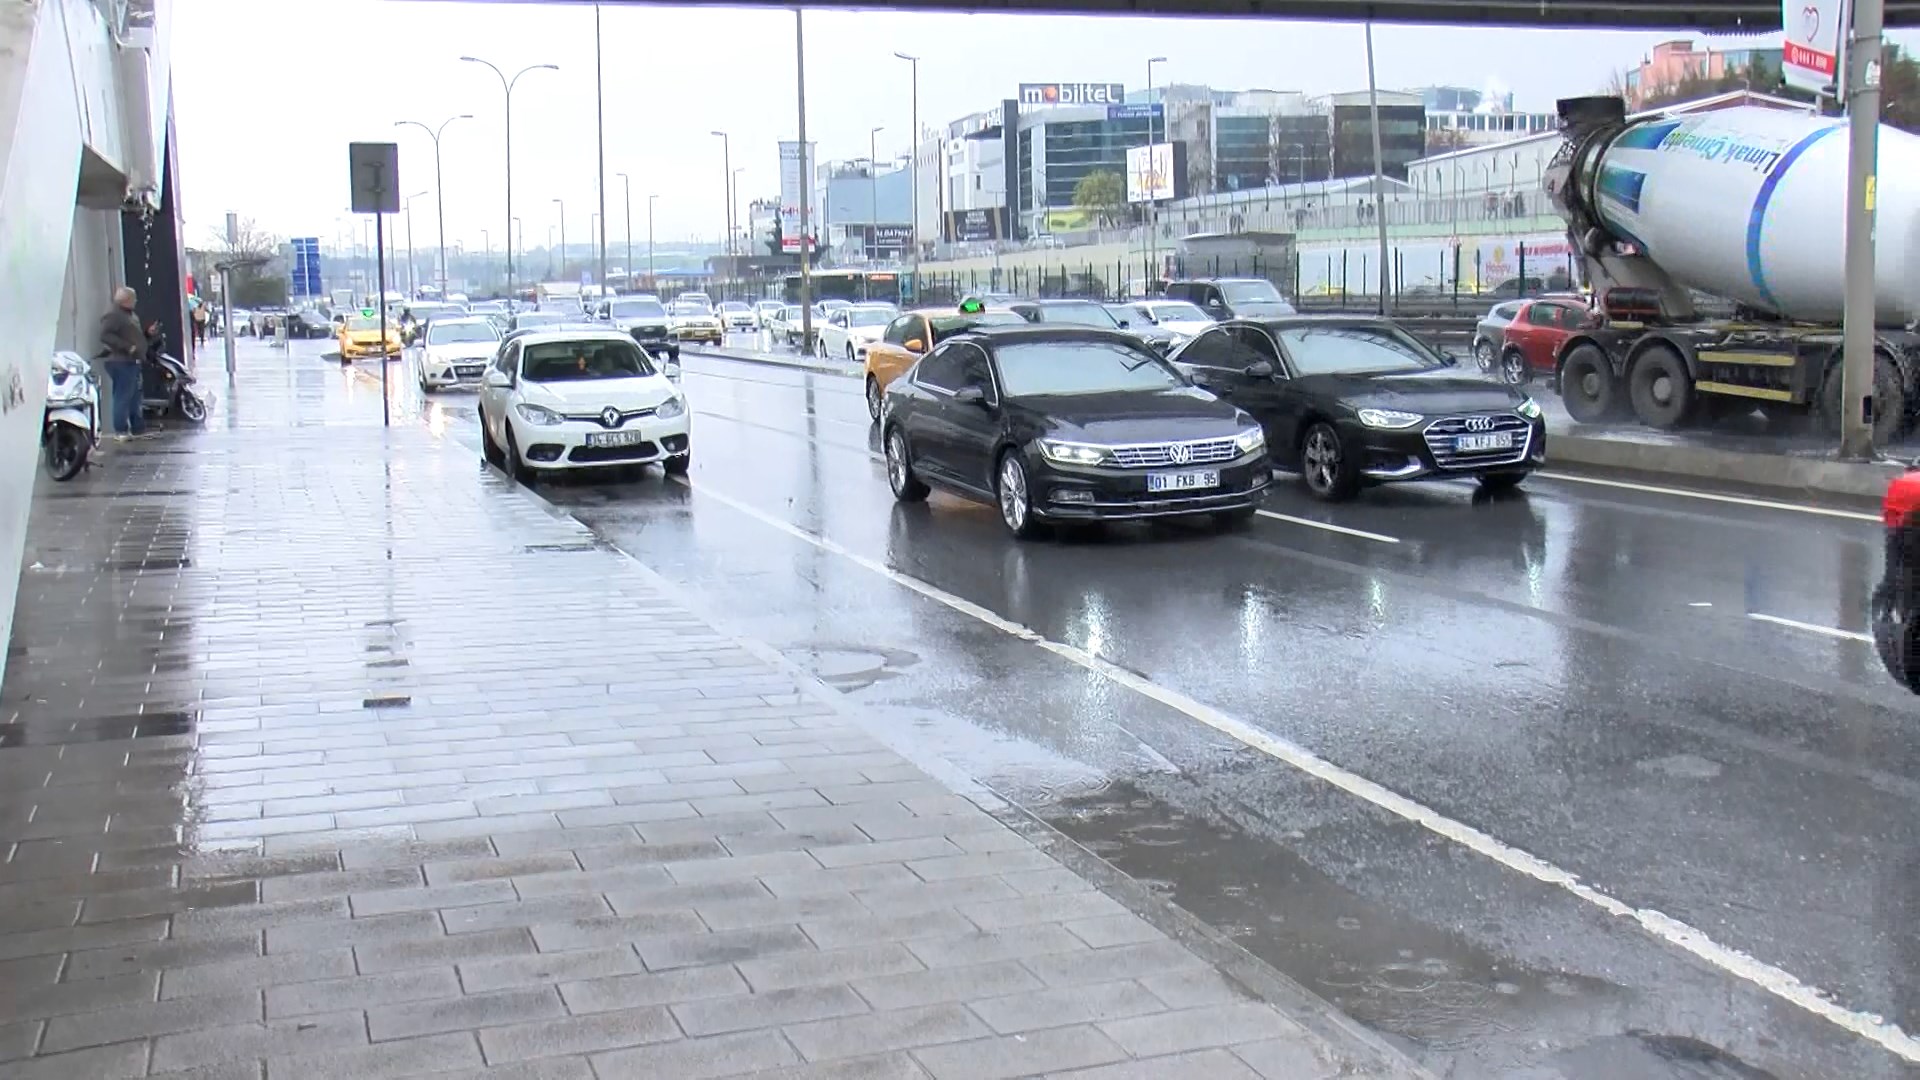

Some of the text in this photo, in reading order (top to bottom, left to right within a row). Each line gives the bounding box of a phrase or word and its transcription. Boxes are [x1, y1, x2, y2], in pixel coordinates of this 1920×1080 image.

[1024, 84, 1119, 103] mobiltel
[1722, 142, 1781, 174] Limak
[1155, 477, 1167, 488] 01
